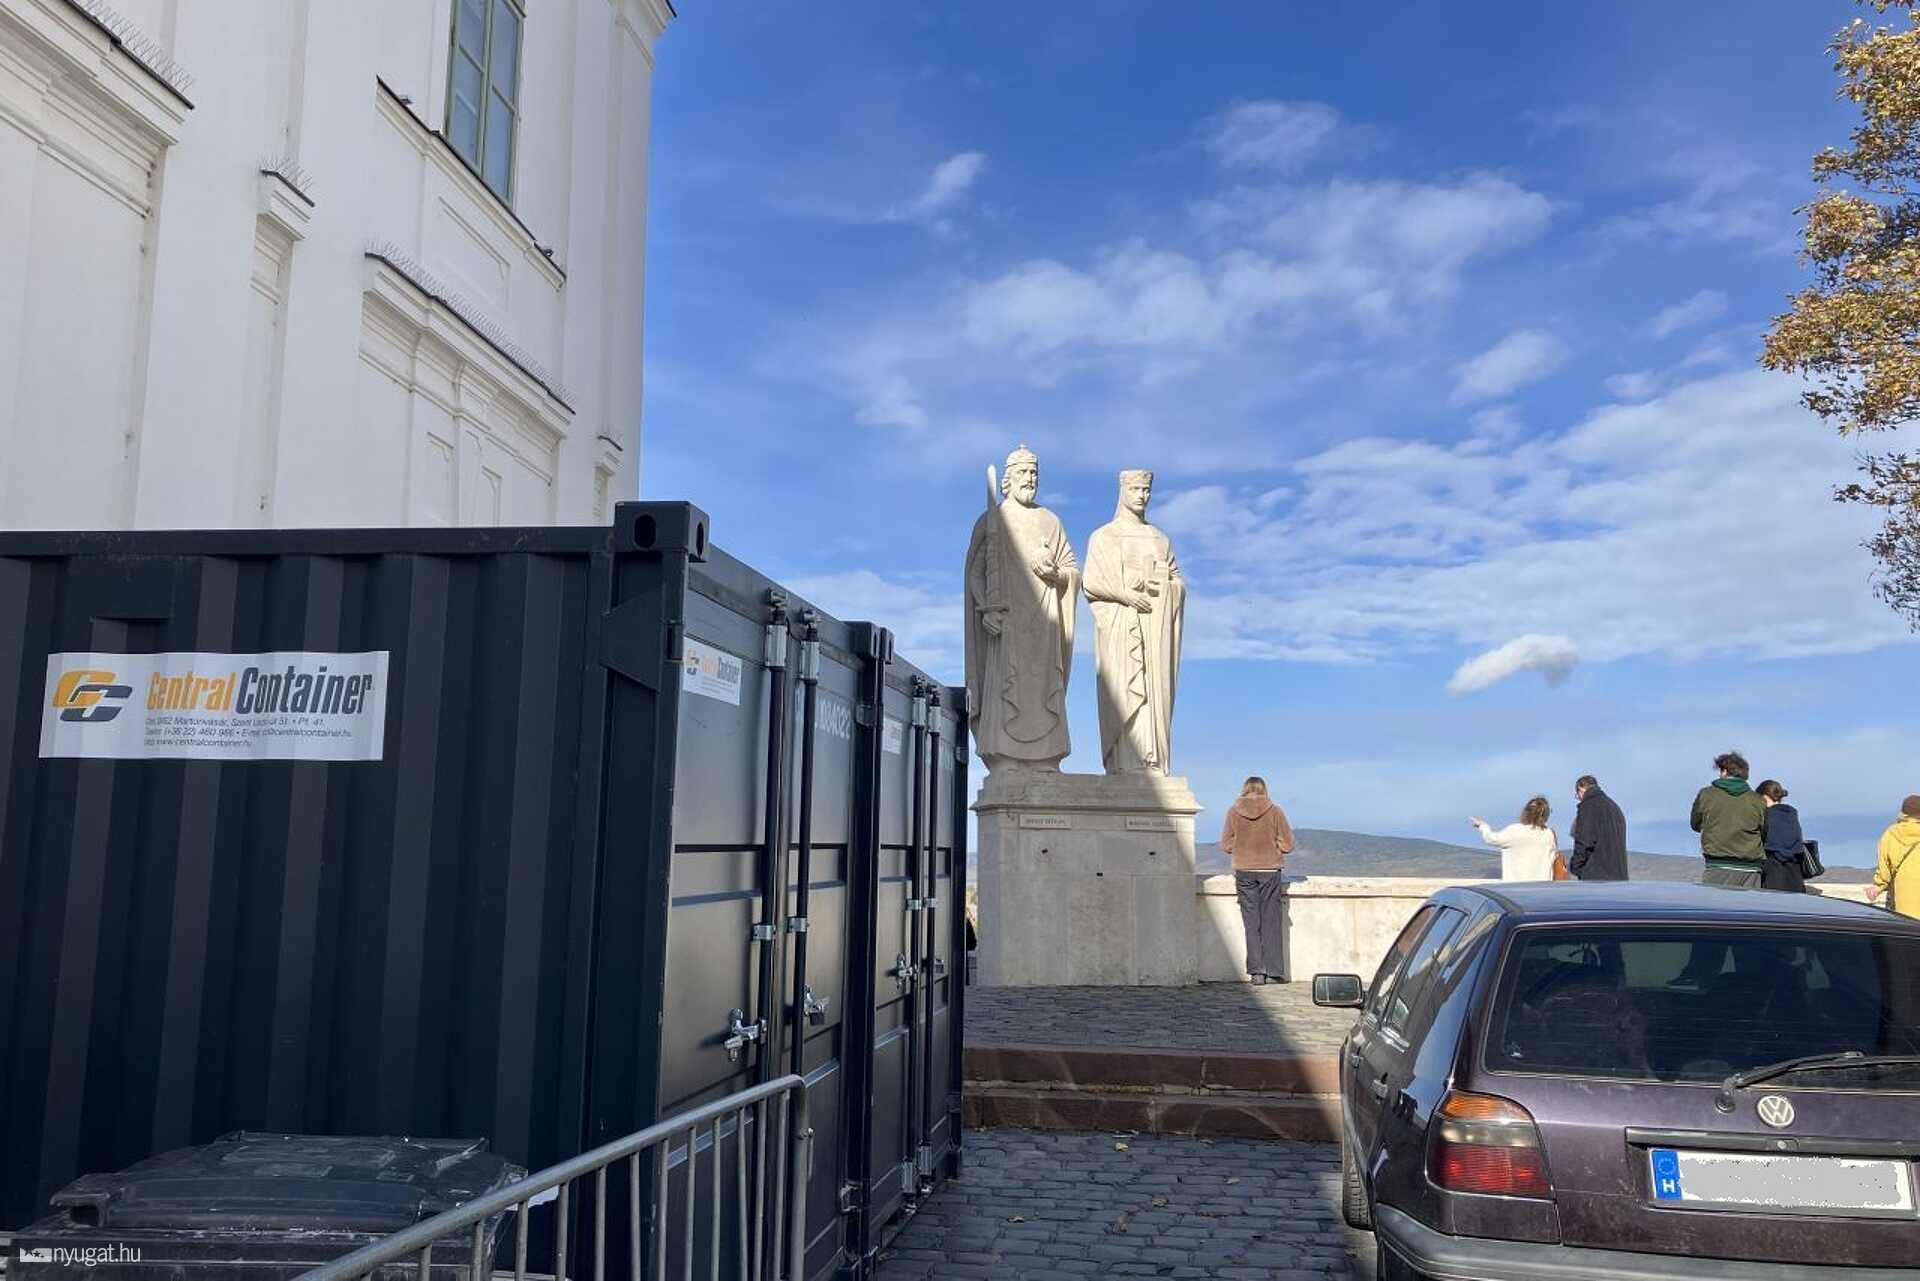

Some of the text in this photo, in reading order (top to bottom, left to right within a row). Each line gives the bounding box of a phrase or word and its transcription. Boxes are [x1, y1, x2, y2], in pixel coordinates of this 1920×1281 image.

[145, 665, 373, 715] Central Container
[1662, 1179, 1676, 1193] H
